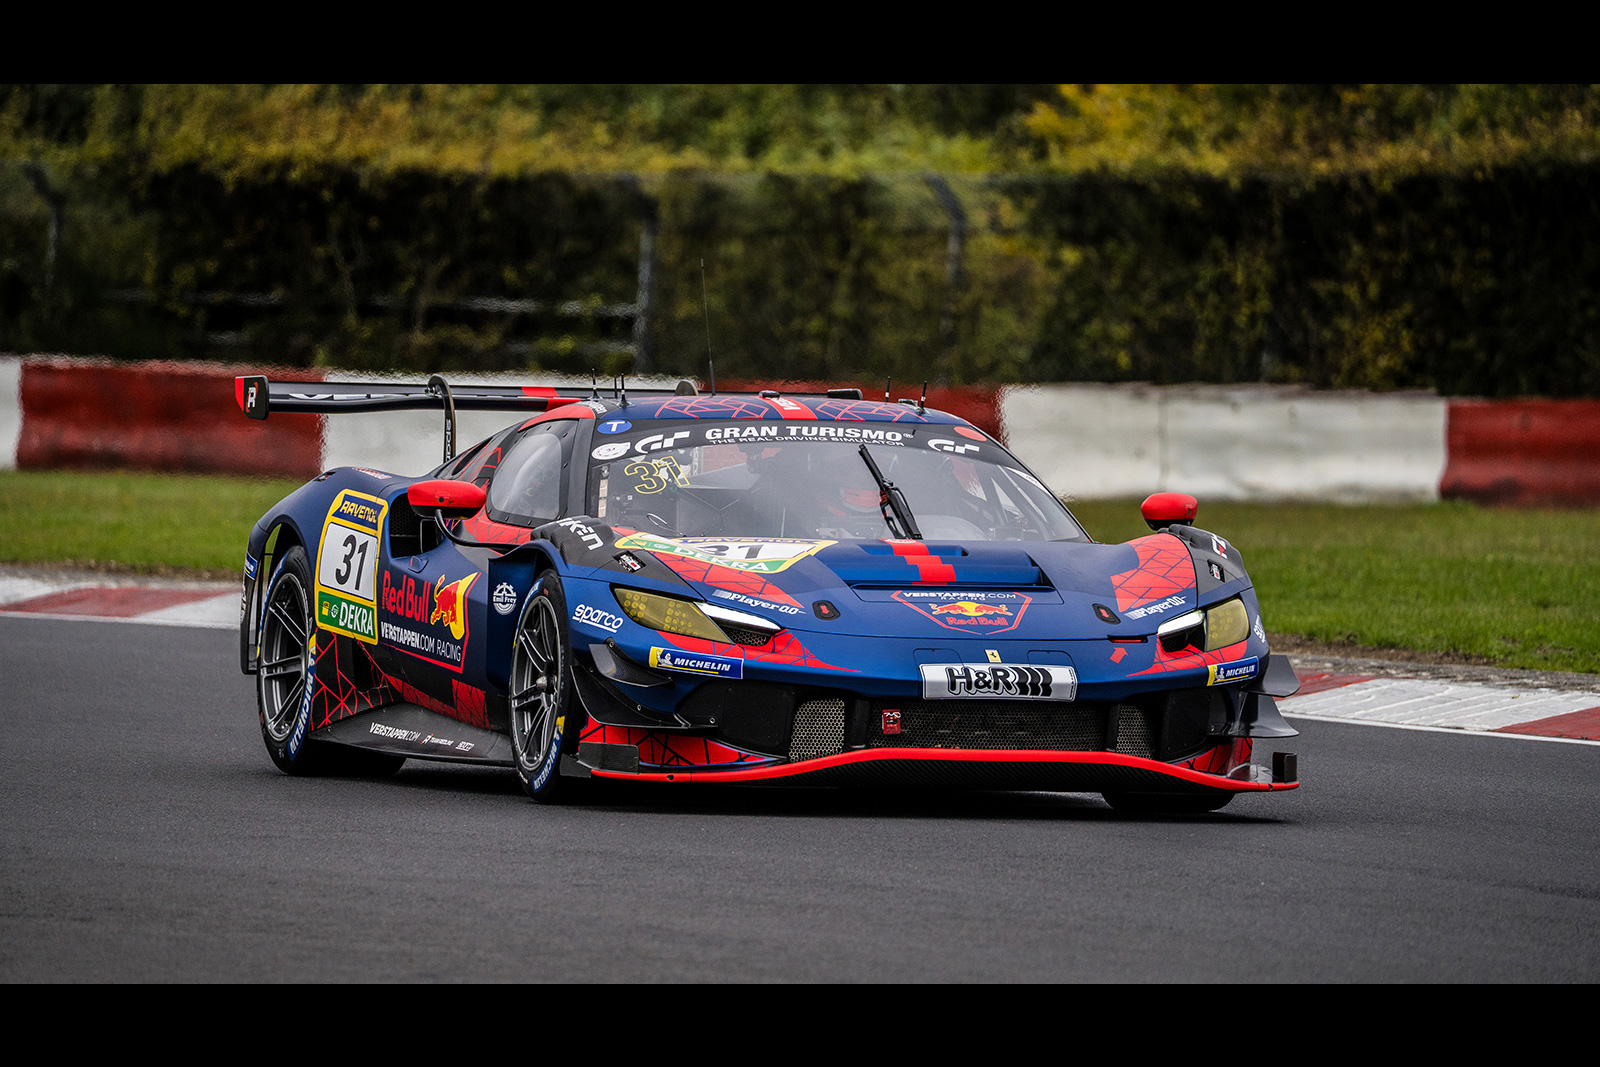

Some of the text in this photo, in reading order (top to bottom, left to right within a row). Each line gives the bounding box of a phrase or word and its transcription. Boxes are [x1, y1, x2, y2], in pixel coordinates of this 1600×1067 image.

[606, 421, 626, 432] T
[705, 426, 778, 440] GRAN
[634, 430, 691, 454] GT
[708, 437, 736, 445] THE
[830, 436, 905, 447] SIMULATOR
[927, 438, 980, 454] GT
[623, 455, 691, 495] 31
[339, 500, 378, 524] RAVENOL
[335, 534, 369, 591] 31
[673, 546, 770, 572] DEKRA
[697, 544, 764, 560] 31
[338, 601, 374, 636] DEKRA
[572, 603, 624, 630] sparco
[380, 621, 462, 662] VERSTAPPEN.COM RACING
[673, 657, 731, 671] MICHELIN
[1225, 664, 1256, 678] MICHELIN
[945, 666, 1018, 696] H&R
[289, 671, 314, 755] MICHELIN
[369, 722, 421, 742] VERSTAPPEN.COM
[533, 740, 559, 790] MICHELIN
